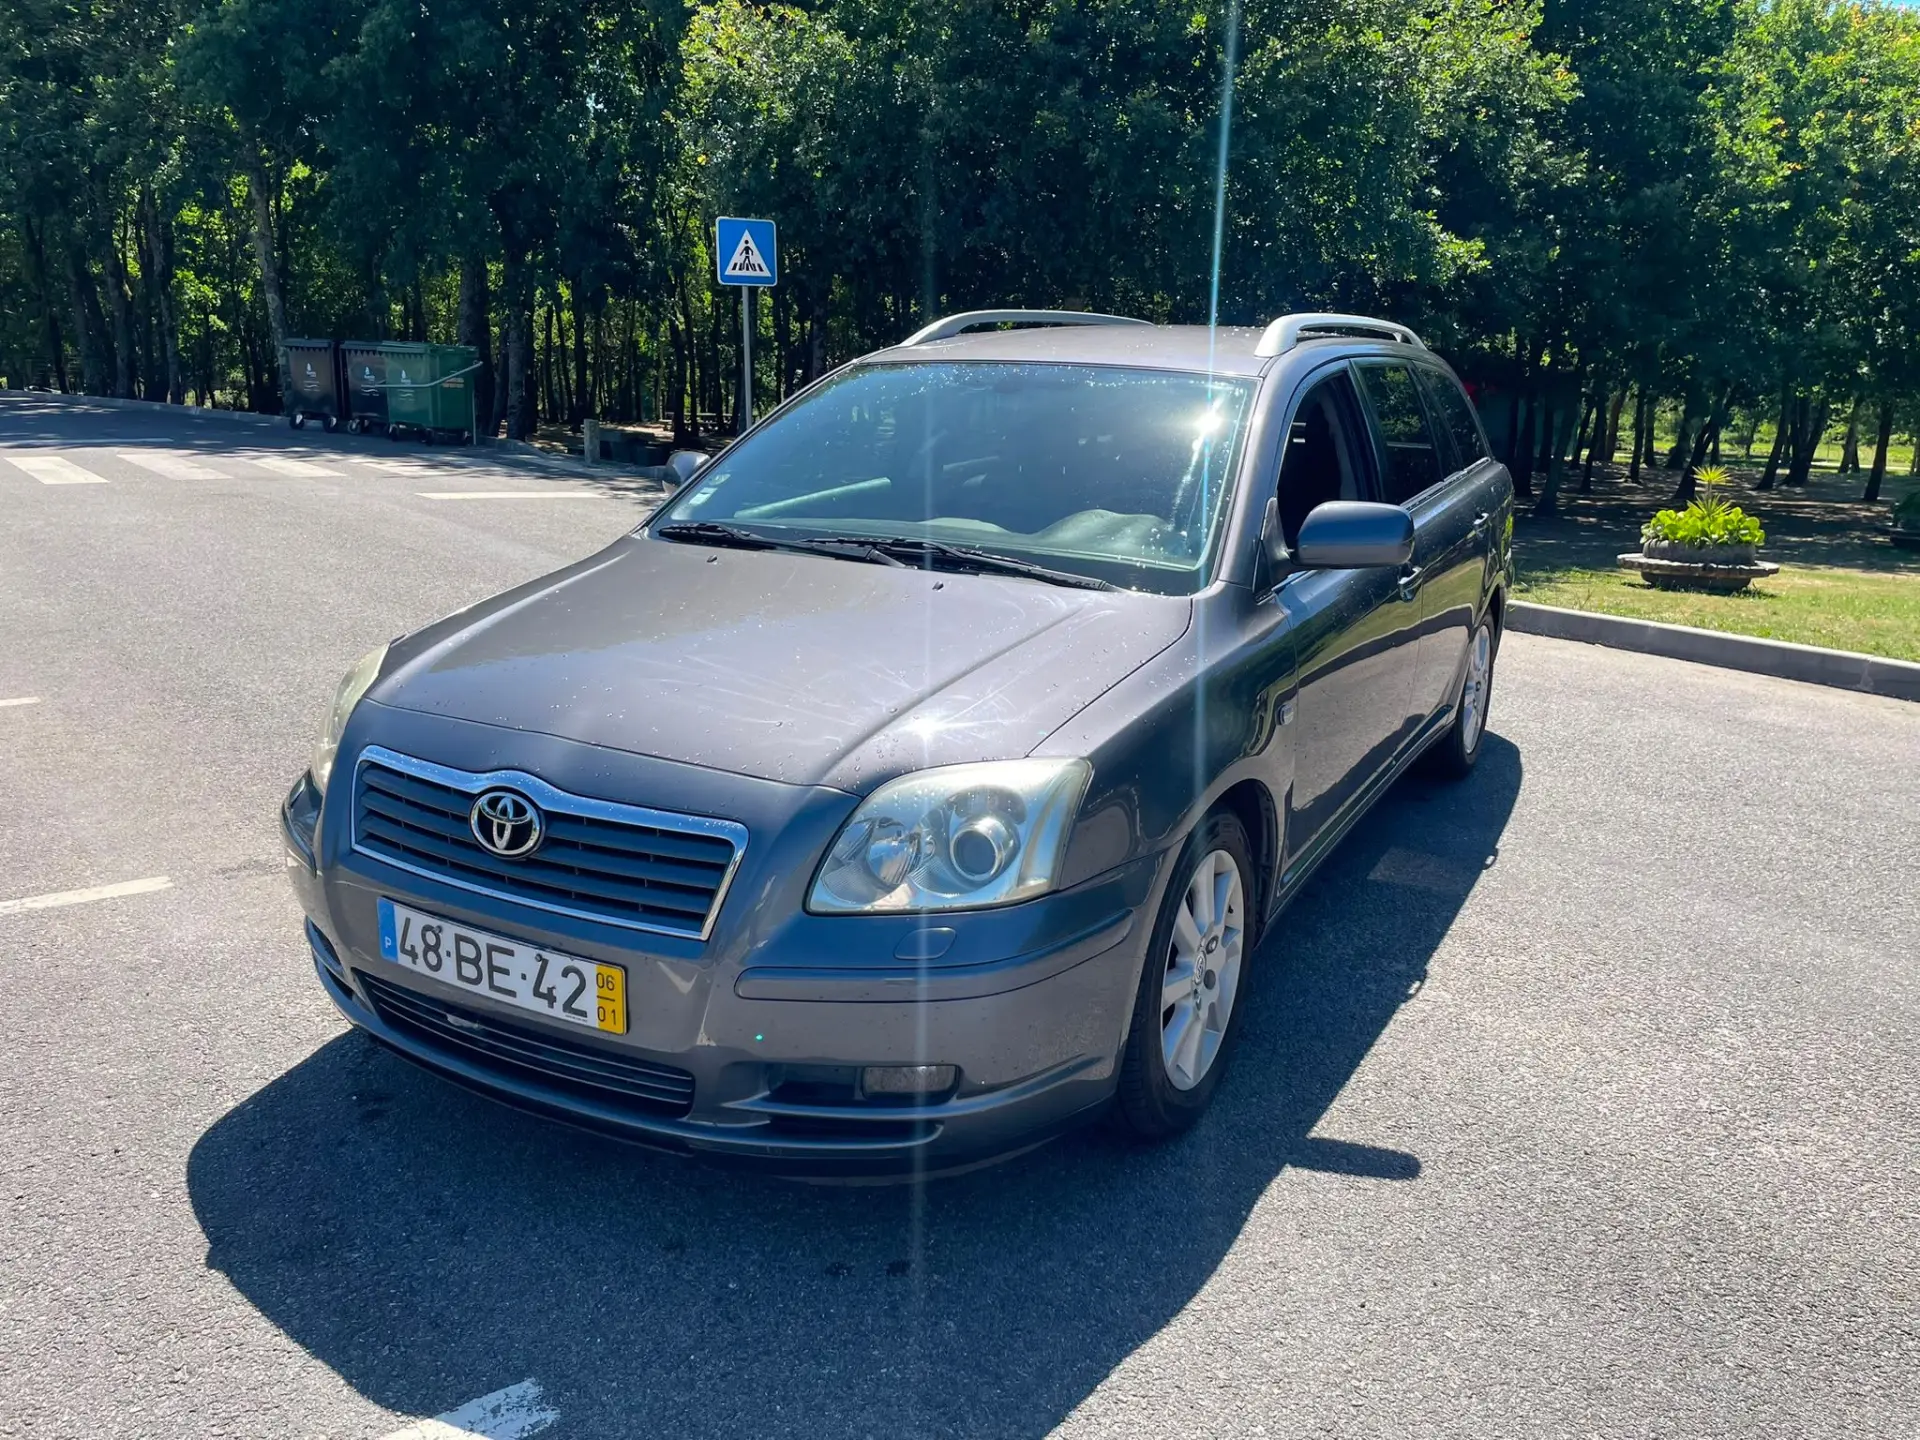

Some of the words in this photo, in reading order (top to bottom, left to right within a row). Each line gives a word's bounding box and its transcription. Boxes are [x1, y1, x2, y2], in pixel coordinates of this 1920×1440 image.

[384, 936, 392, 949] P
[596, 972, 615, 991] 06
[597, 1007, 616, 1026] 01
